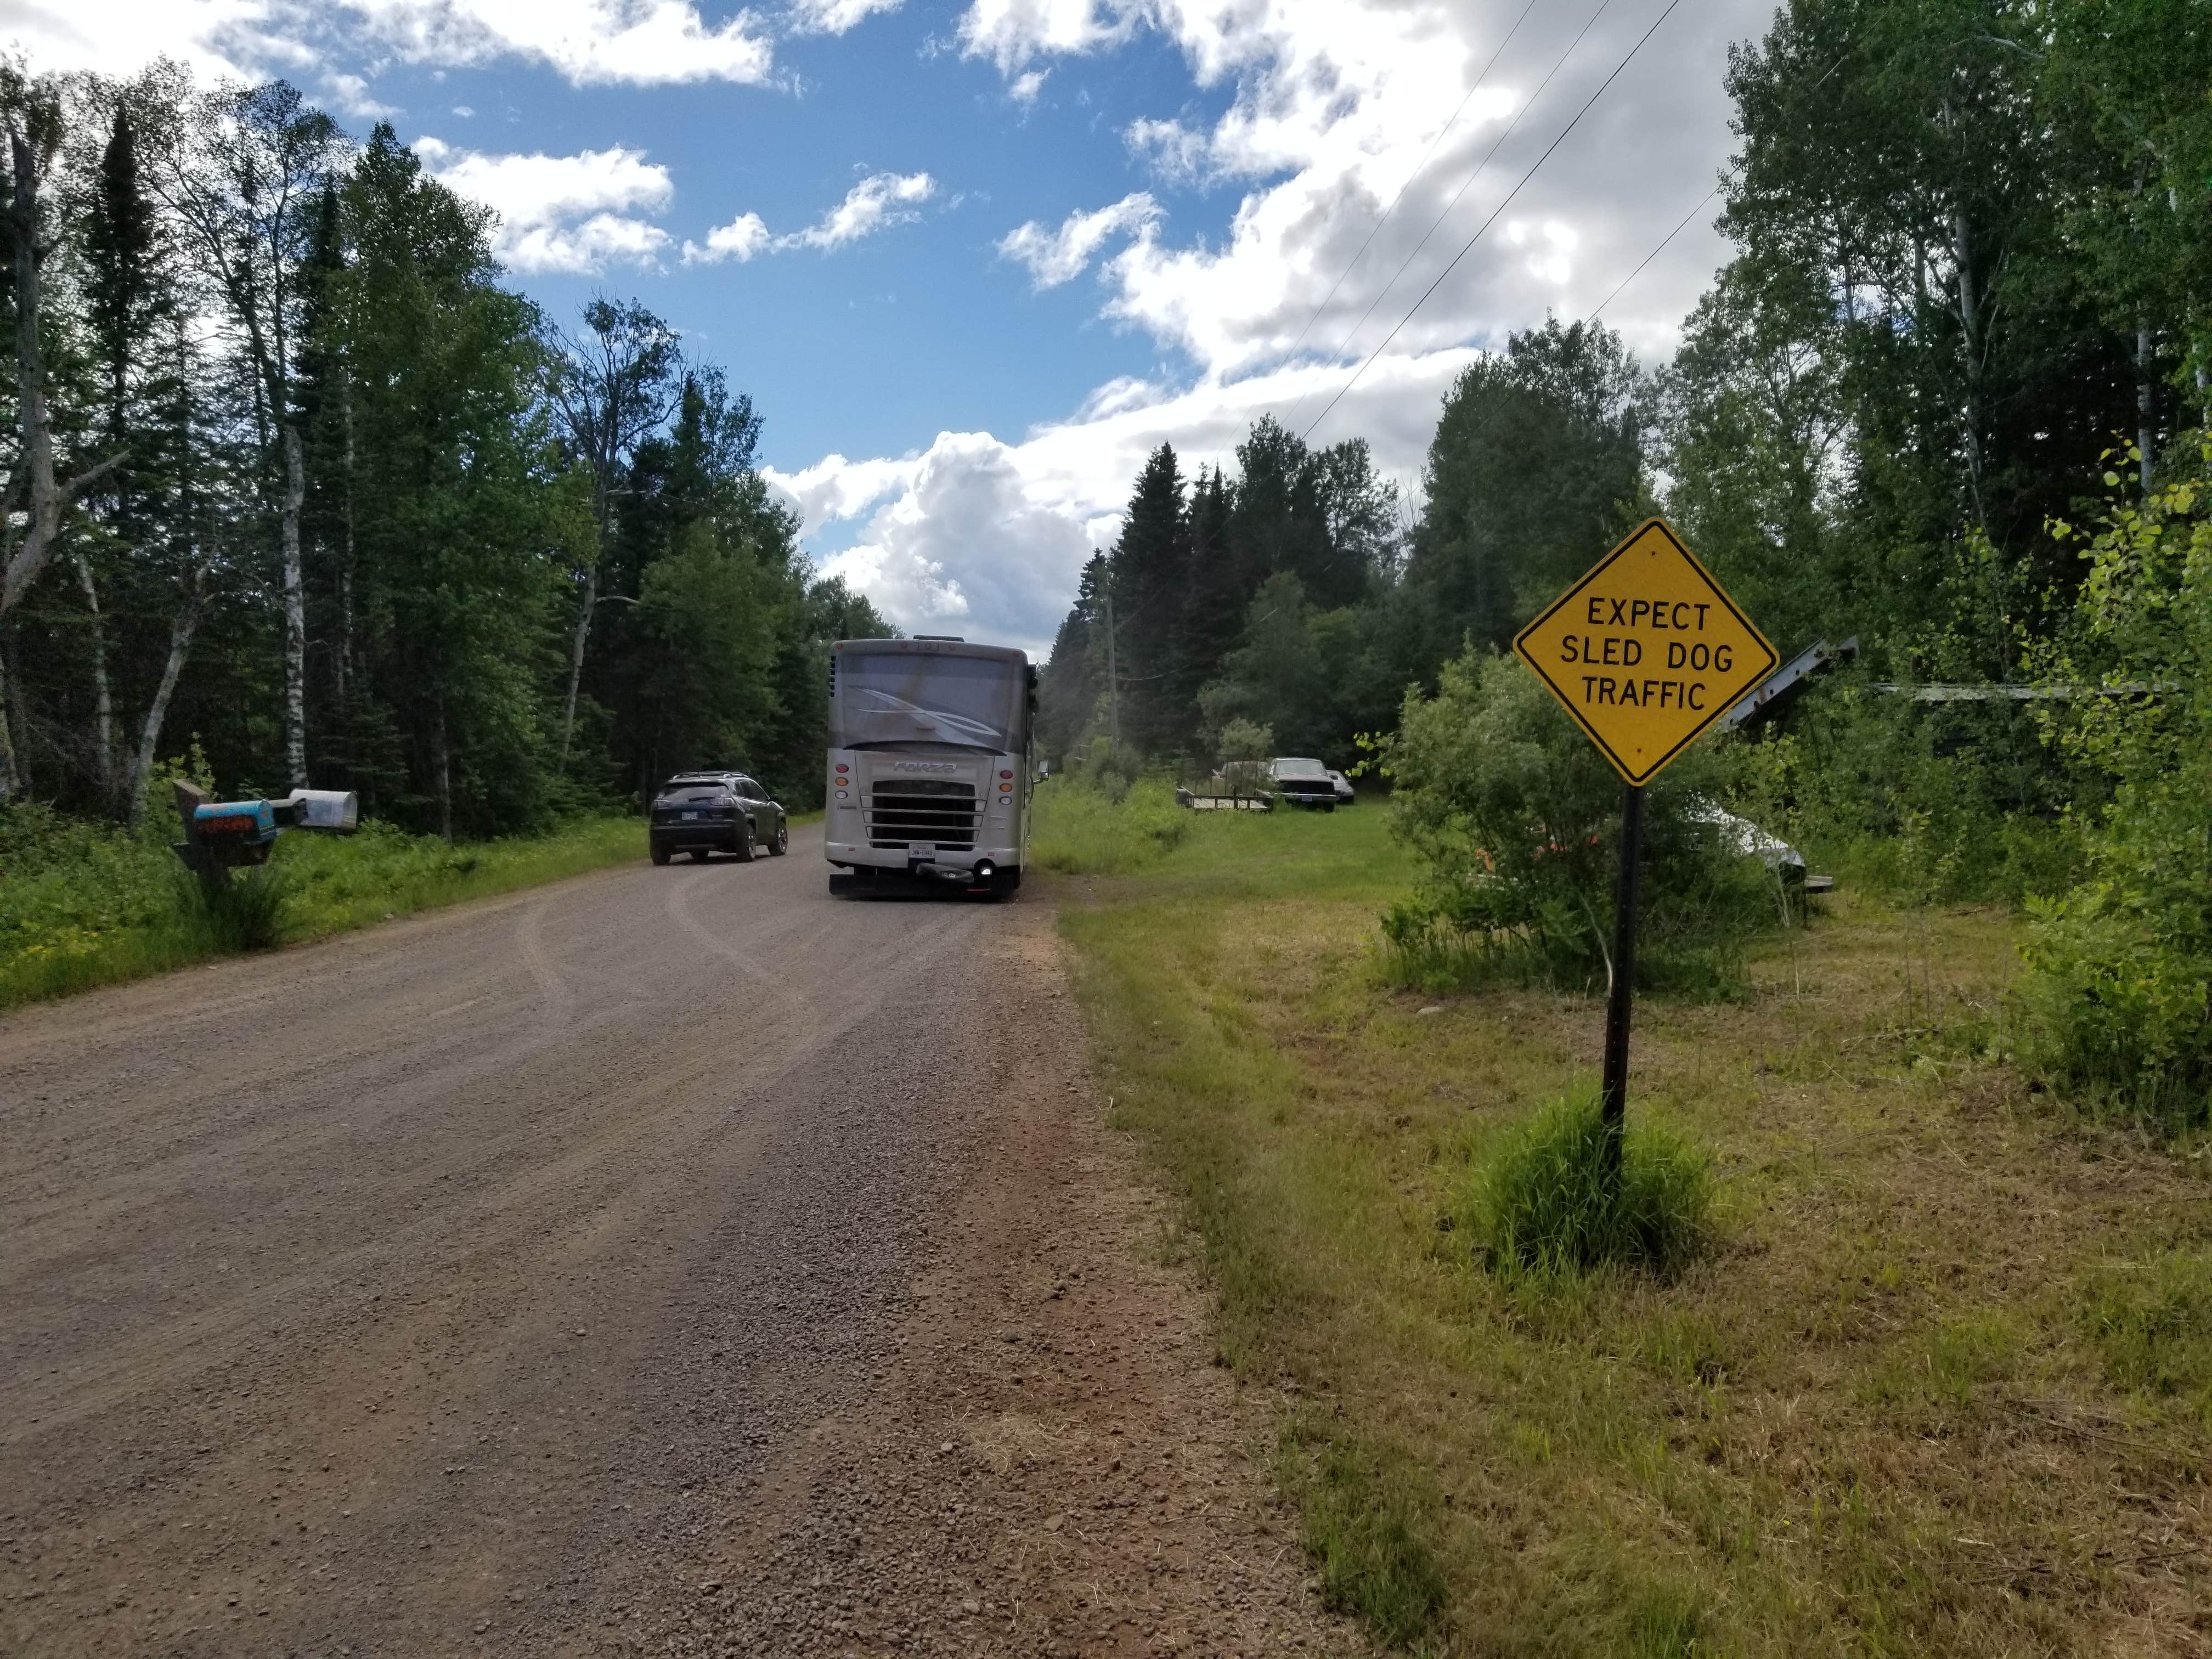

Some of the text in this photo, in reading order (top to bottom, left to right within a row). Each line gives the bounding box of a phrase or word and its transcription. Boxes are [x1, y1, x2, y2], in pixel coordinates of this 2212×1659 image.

[1588, 597, 1711, 631] EXPECT
[1560, 635, 1733, 673] SLED DOG
[1582, 676, 1706, 710] TRAFFIC
